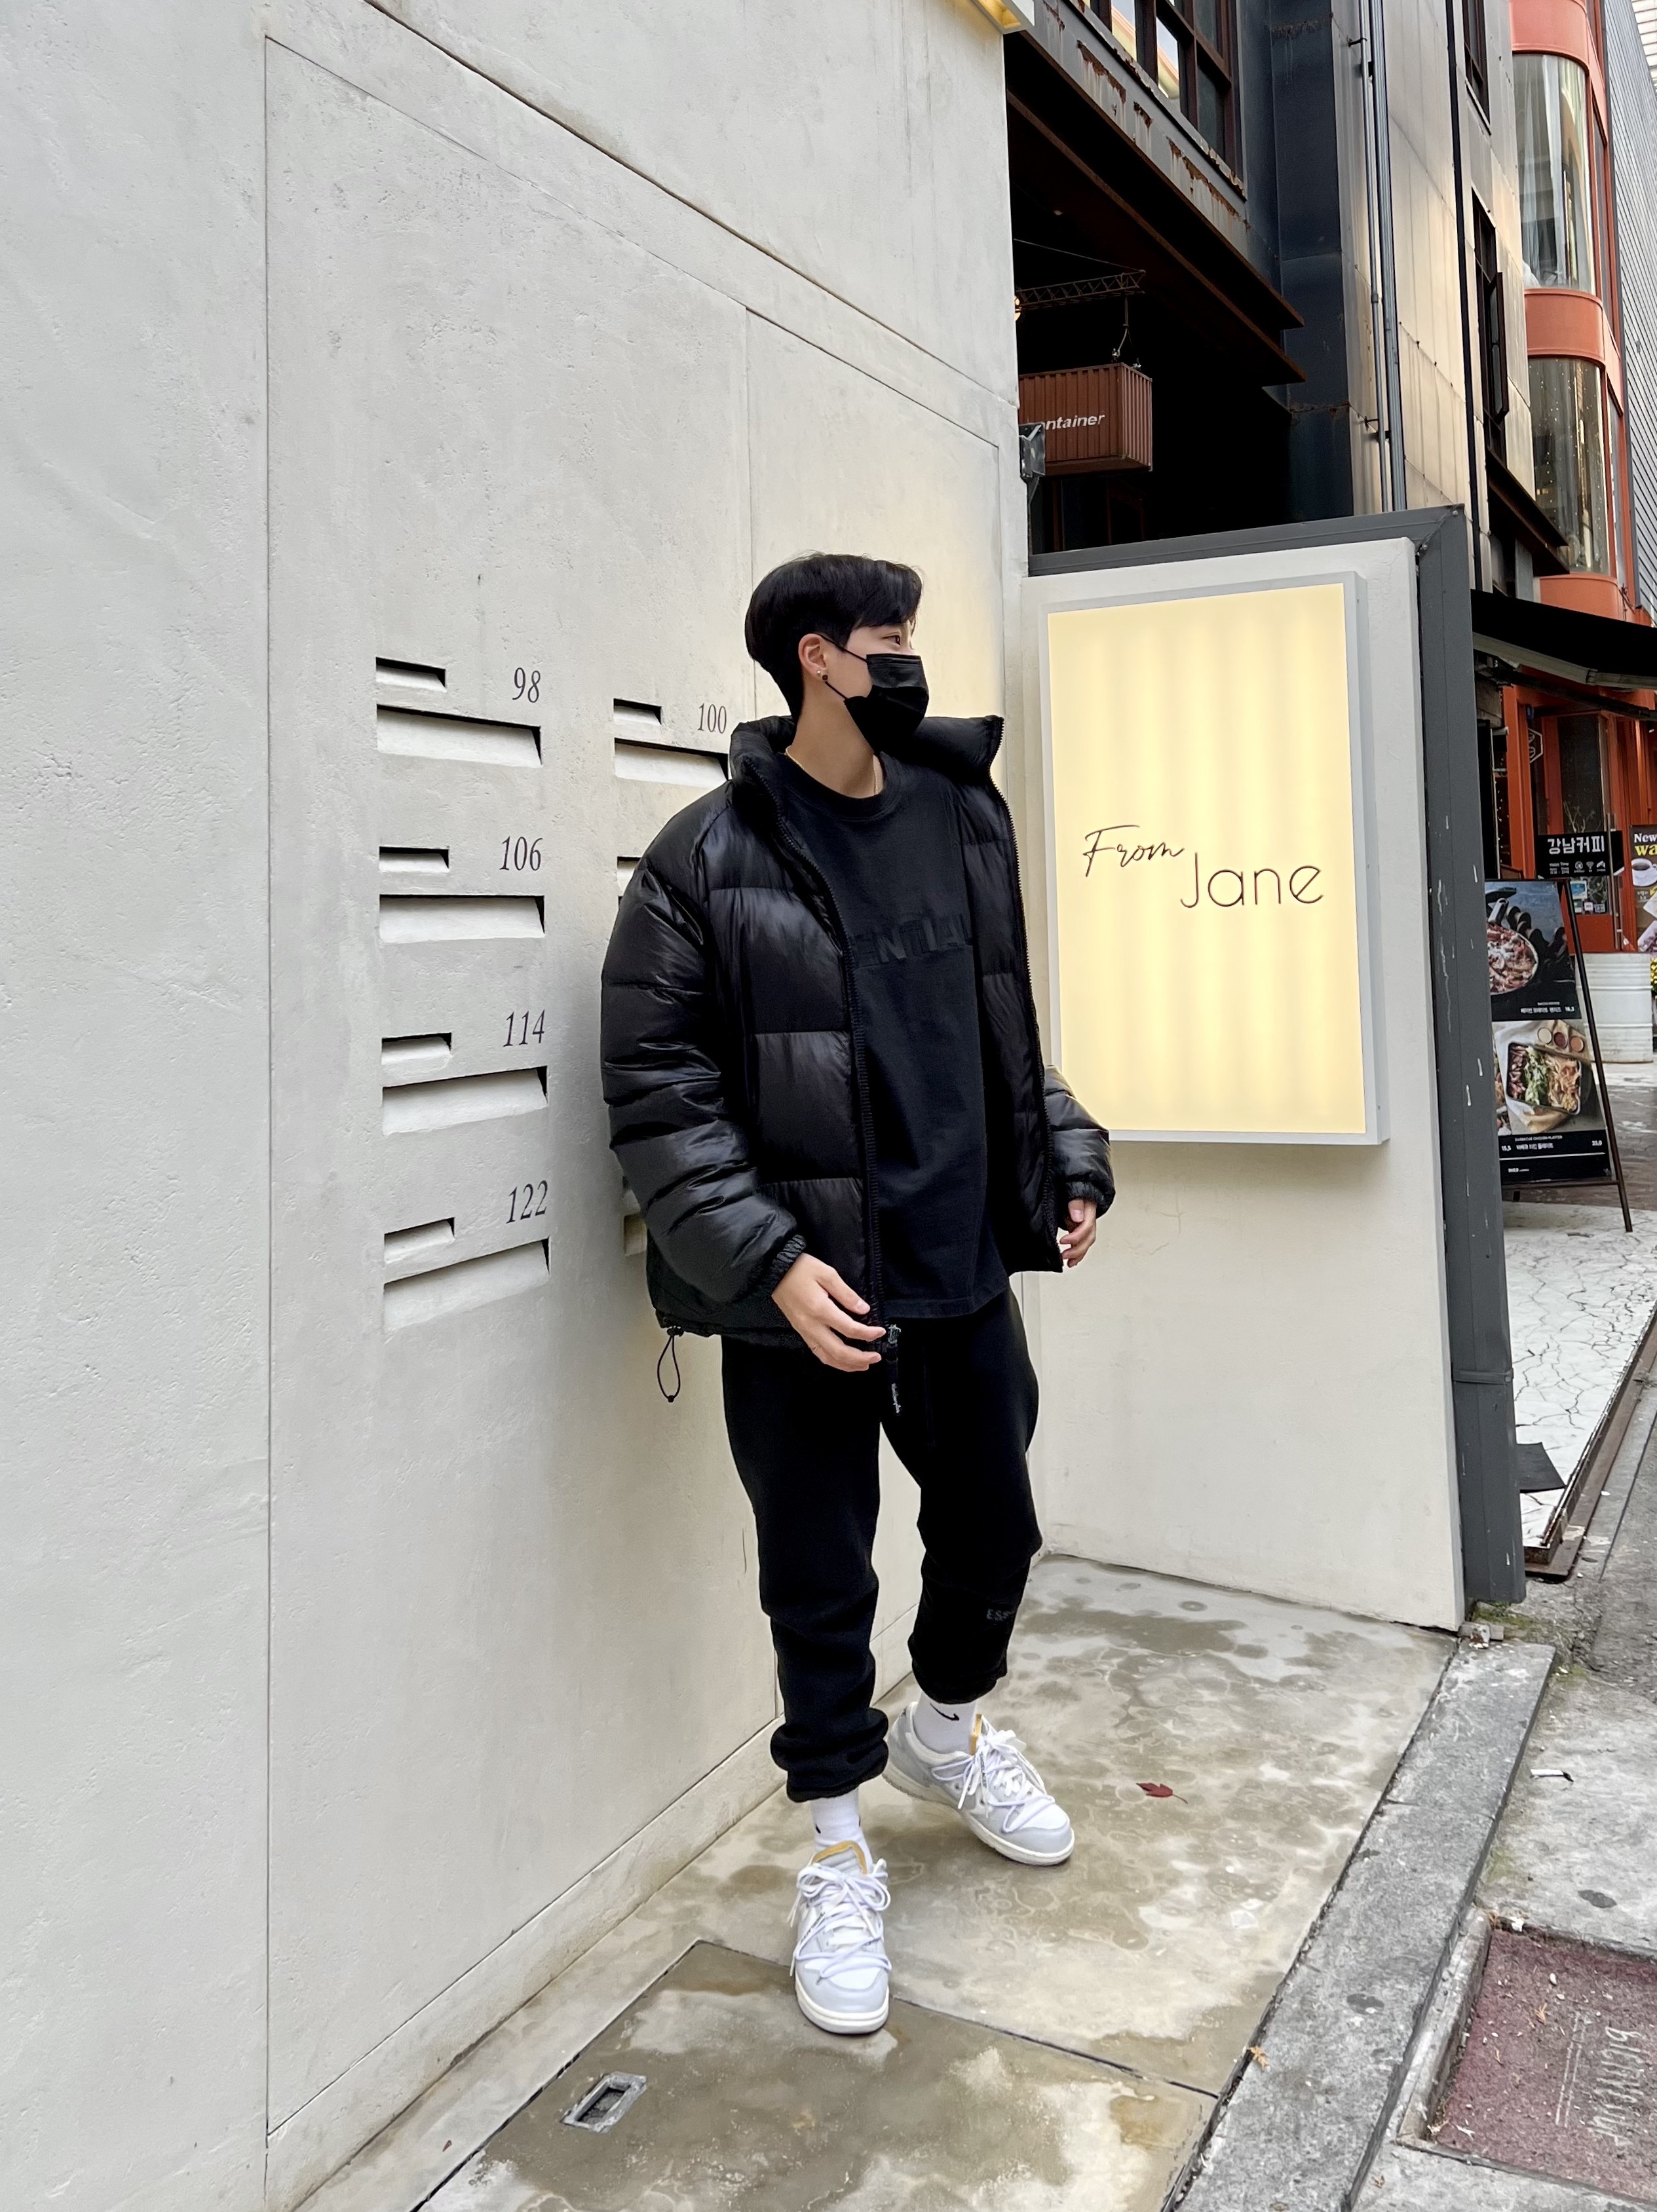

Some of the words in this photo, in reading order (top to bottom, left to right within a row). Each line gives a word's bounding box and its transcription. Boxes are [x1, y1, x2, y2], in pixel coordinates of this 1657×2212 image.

[1045, 415, 1105, 430] ntainer
[512, 667, 541, 703] 98
[697, 702, 727, 734] 100
[499, 836, 543, 871] 106
[1082, 824, 1185, 878] From
[1547, 835, 1605, 855] 강남커피
[1633, 833, 1657, 843] New
[1180, 852, 1324, 908] Jane
[503, 1009, 546, 1047] 114
[506, 1180, 548, 1224] 122
